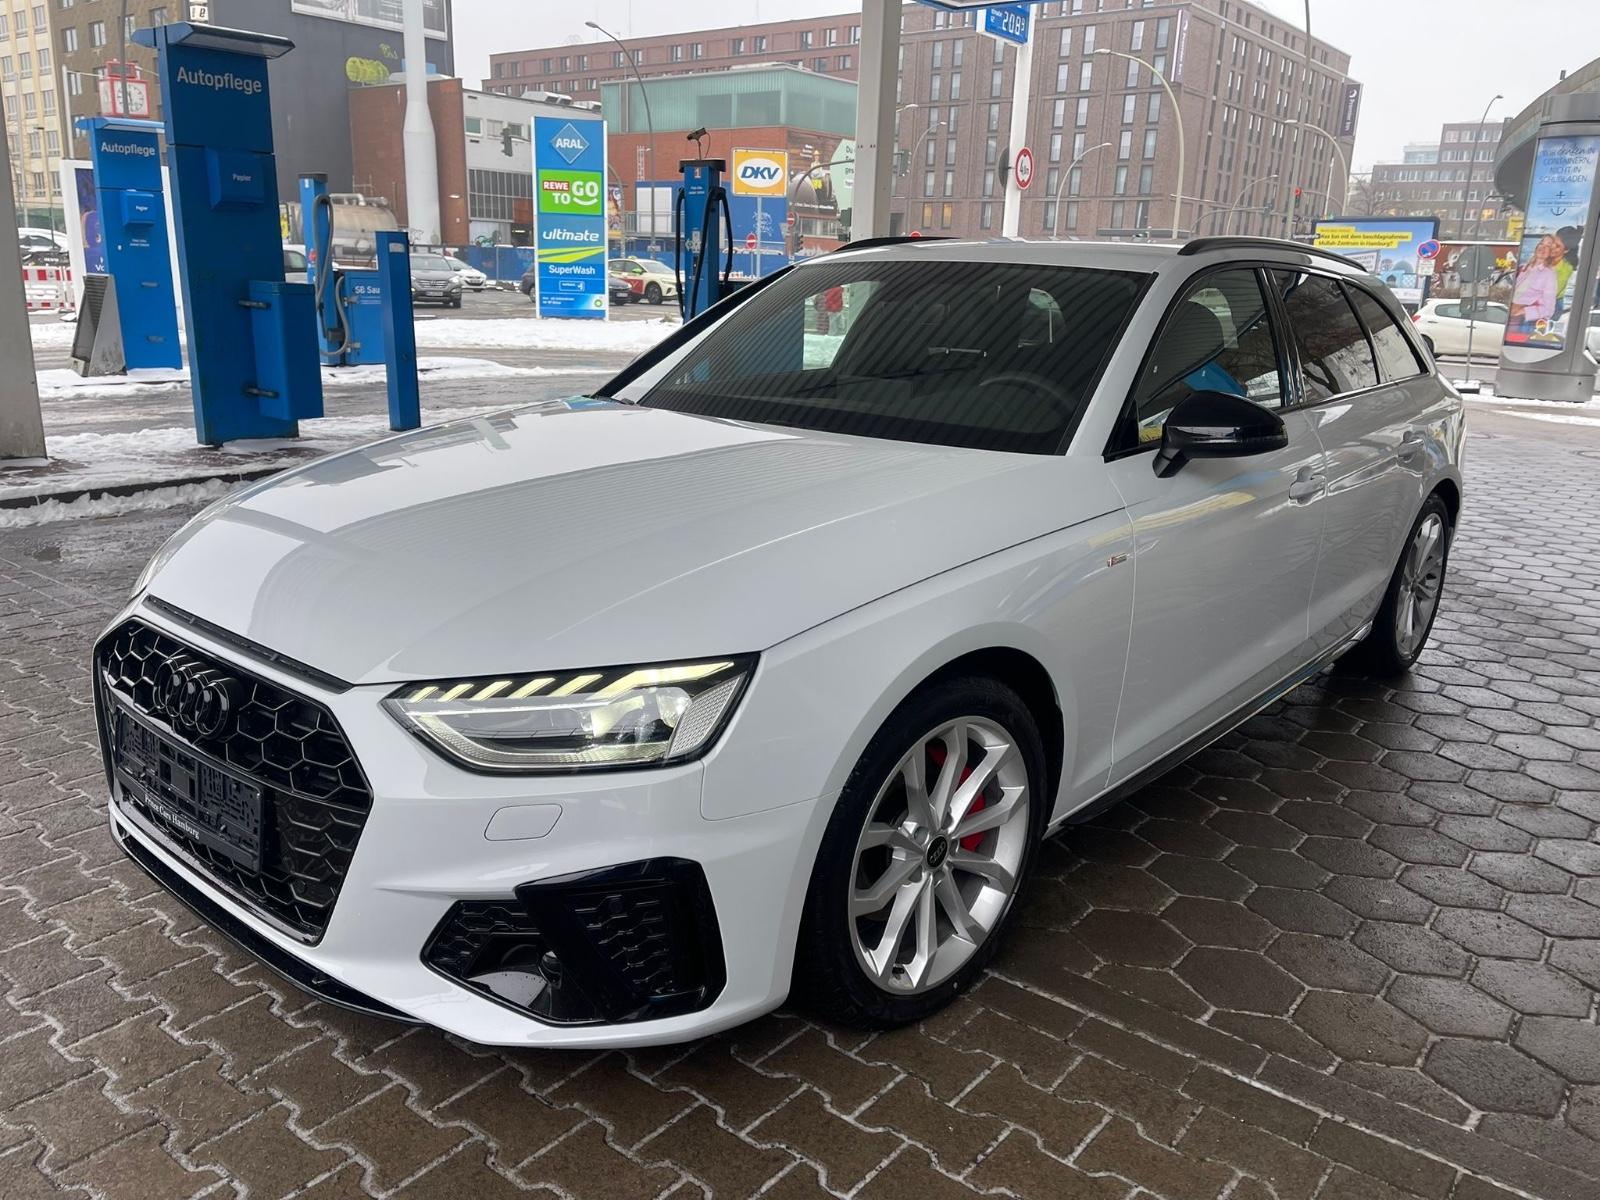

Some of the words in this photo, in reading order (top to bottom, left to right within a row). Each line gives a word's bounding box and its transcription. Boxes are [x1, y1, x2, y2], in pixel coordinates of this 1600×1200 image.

[176, 66, 263, 95] Autopflege
[101, 142, 155, 157] Autopflege
[555, 138, 584, 149] ARAL
[694, 168, 701, 179] 1
[740, 166, 780, 180] DKV
[543, 181, 569, 190] REWE
[571, 181, 599, 198] GO
[552, 192, 571, 204] TO
[542, 229, 600, 242] ultimate
[549, 265, 596, 275] SuperWash
[171, 813, 200, 840] Hamburg
